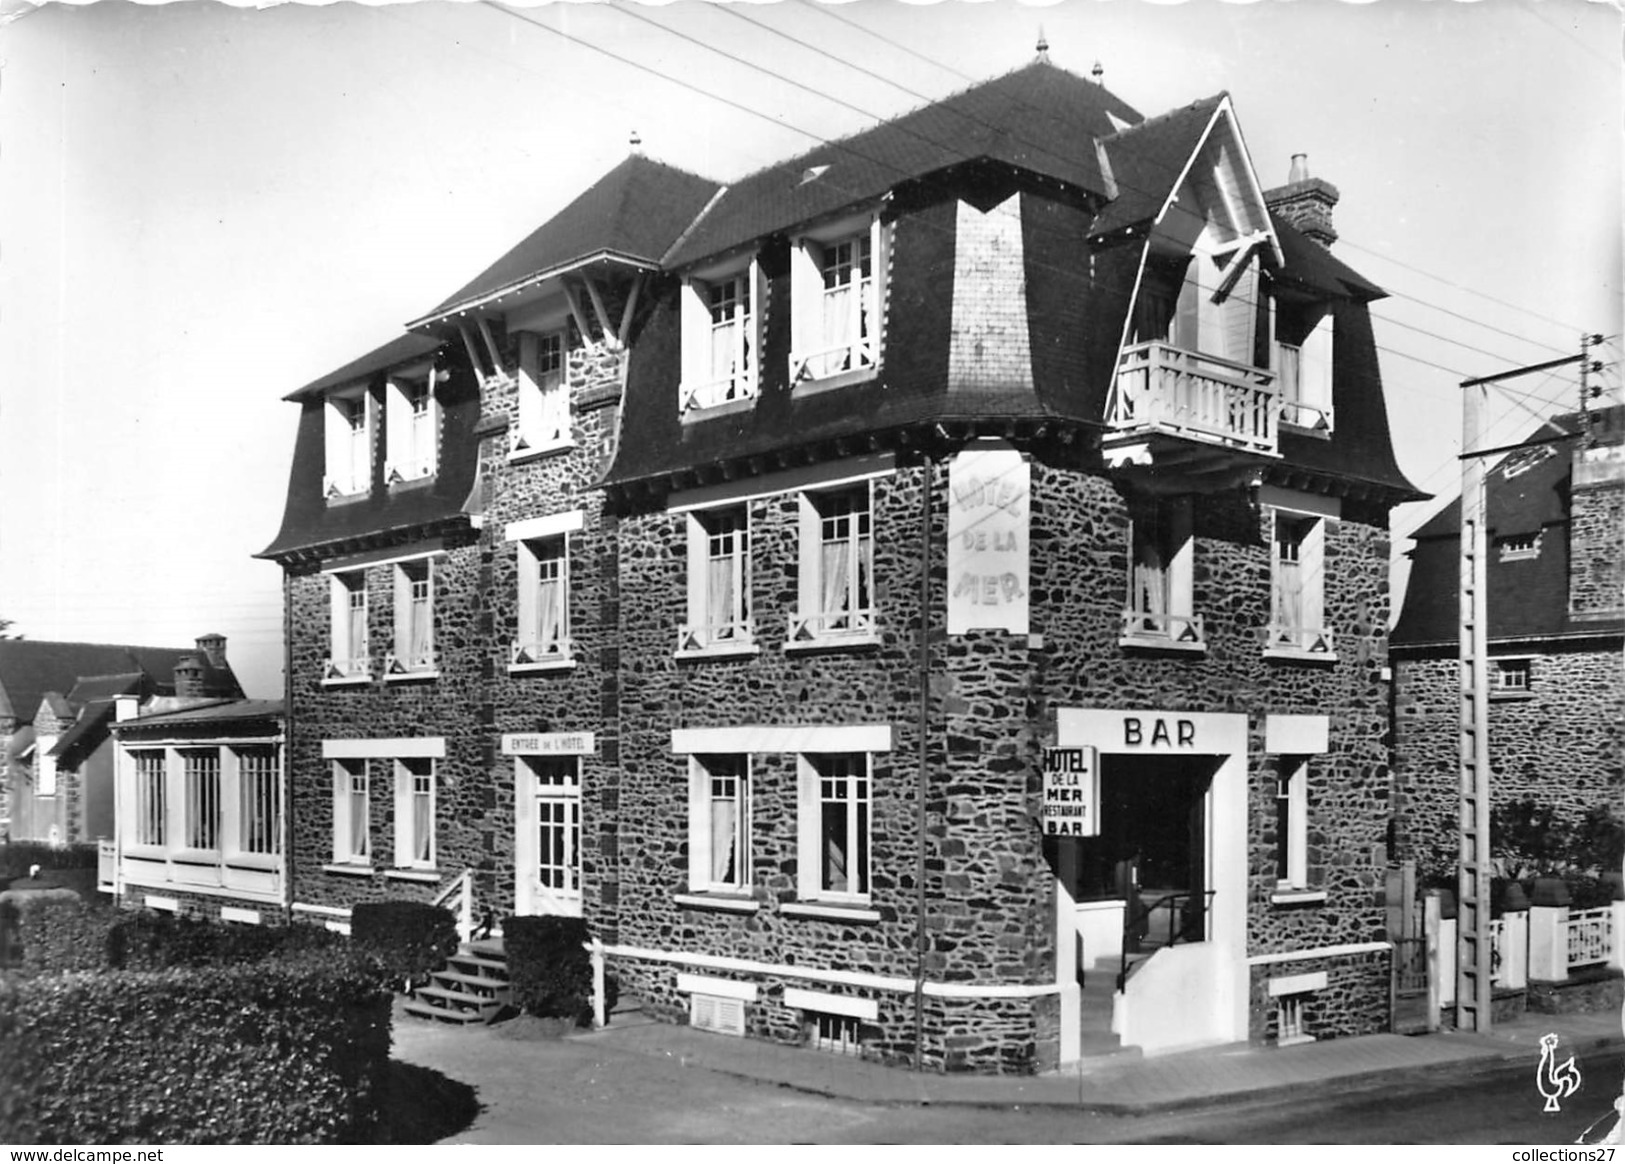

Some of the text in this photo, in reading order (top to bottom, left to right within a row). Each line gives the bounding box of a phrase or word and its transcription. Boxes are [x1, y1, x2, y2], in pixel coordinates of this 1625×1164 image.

[962, 530, 1018, 552] DE LA
[953, 572, 1024, 606] MER
[1124, 717, 1196, 747] BAR
[1052, 773, 1079, 786] DE LA
[1047, 788, 1083, 802] MER
[1043, 804, 1086, 818] RESTAURANT
[1048, 820, 1083, 835] BAR
